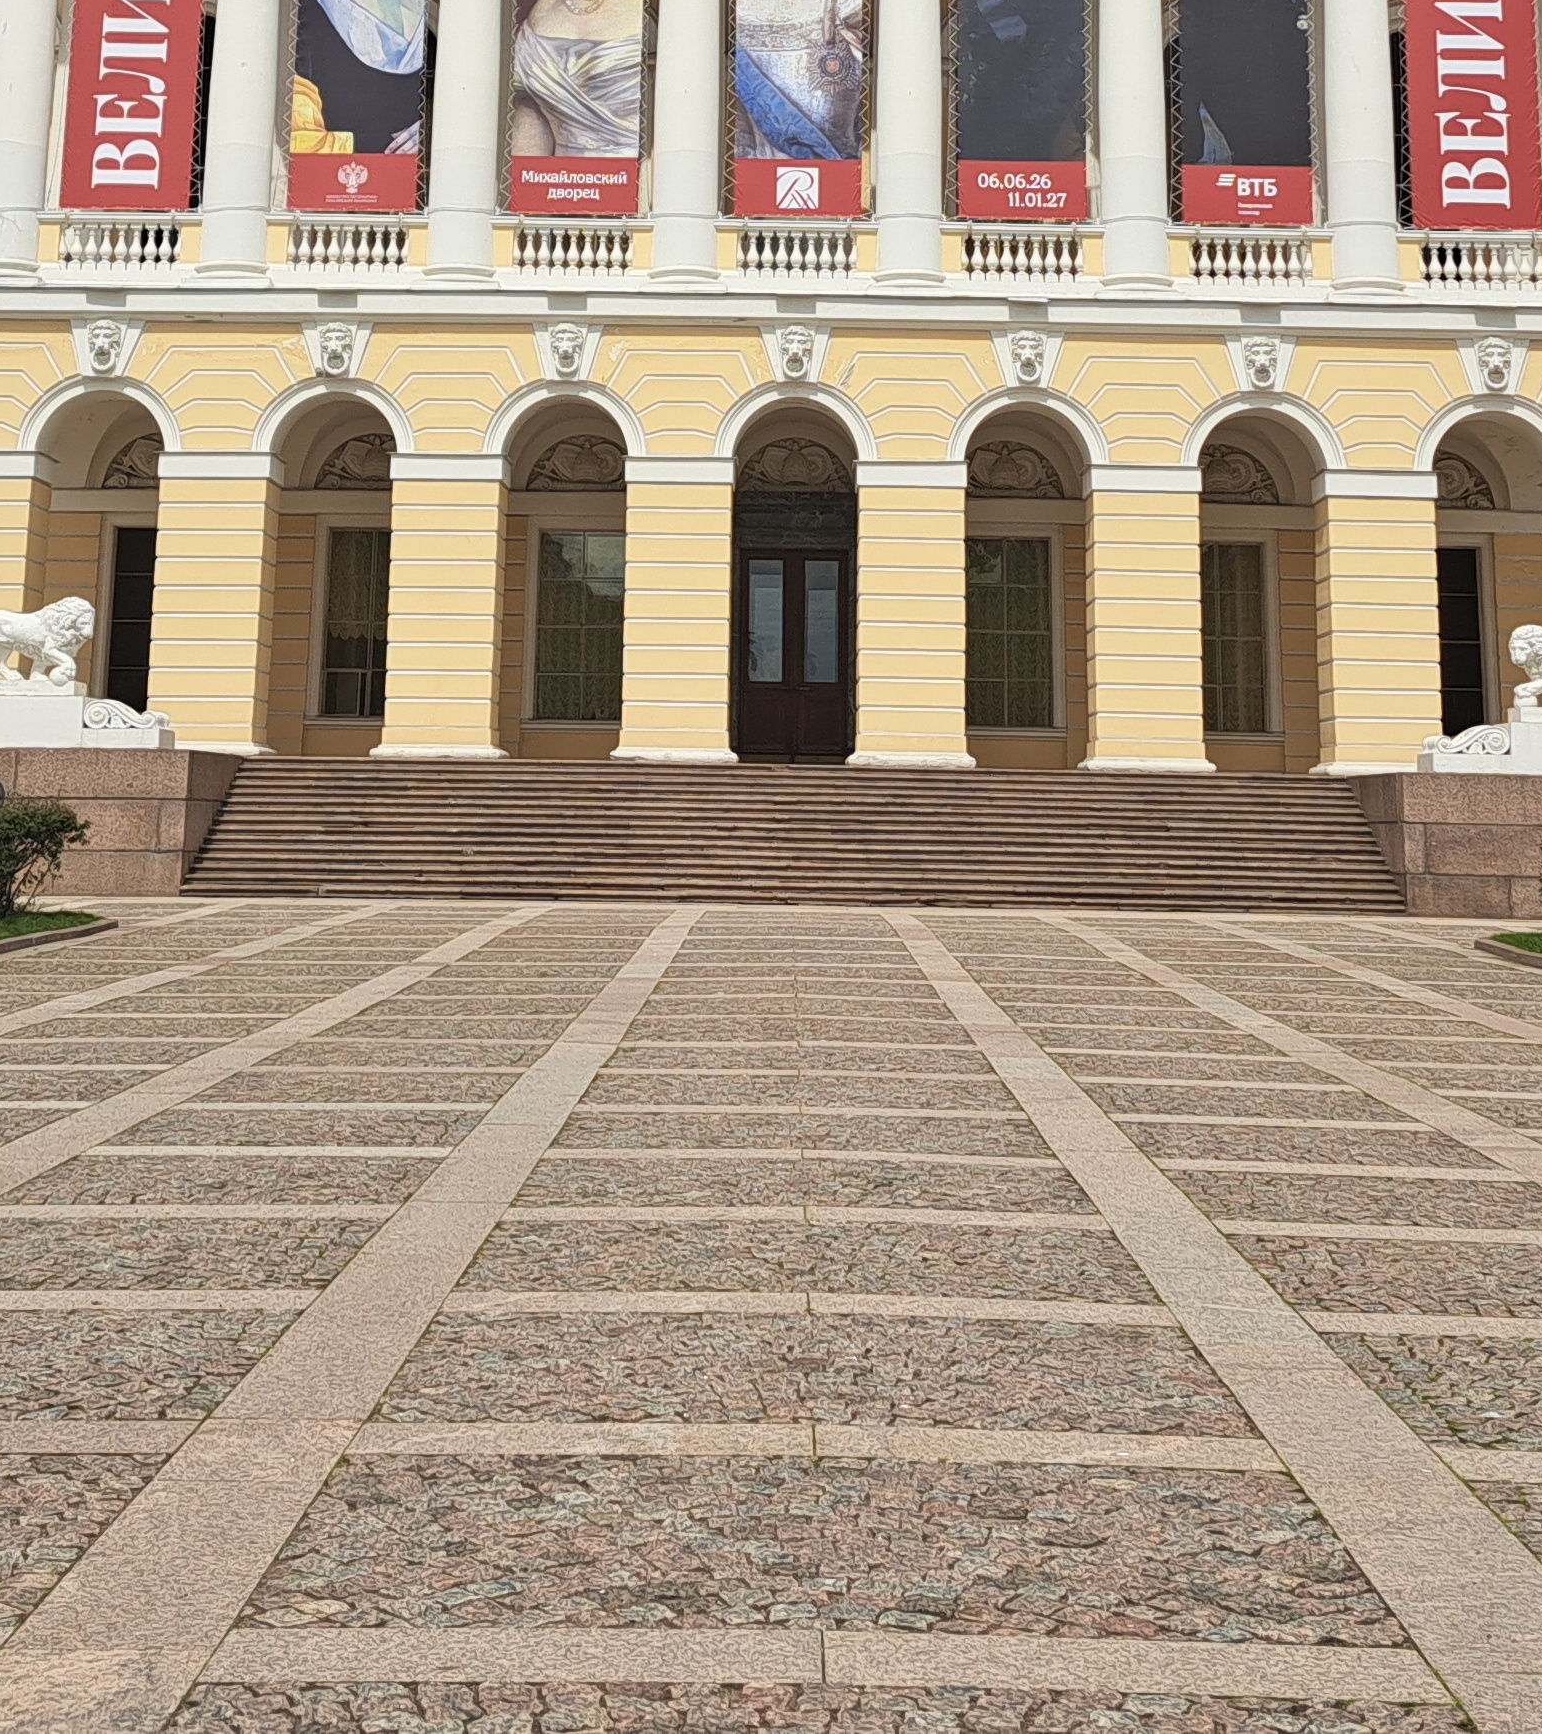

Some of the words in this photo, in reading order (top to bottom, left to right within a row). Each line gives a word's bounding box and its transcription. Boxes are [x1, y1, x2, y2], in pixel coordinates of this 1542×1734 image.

[521, 170, 628, 185] Михайловский
[546, 188, 600, 201] дворец
[1237, 177, 1278, 197] ВТБ
[1007, 191, 1068, 208] 11.01.27
